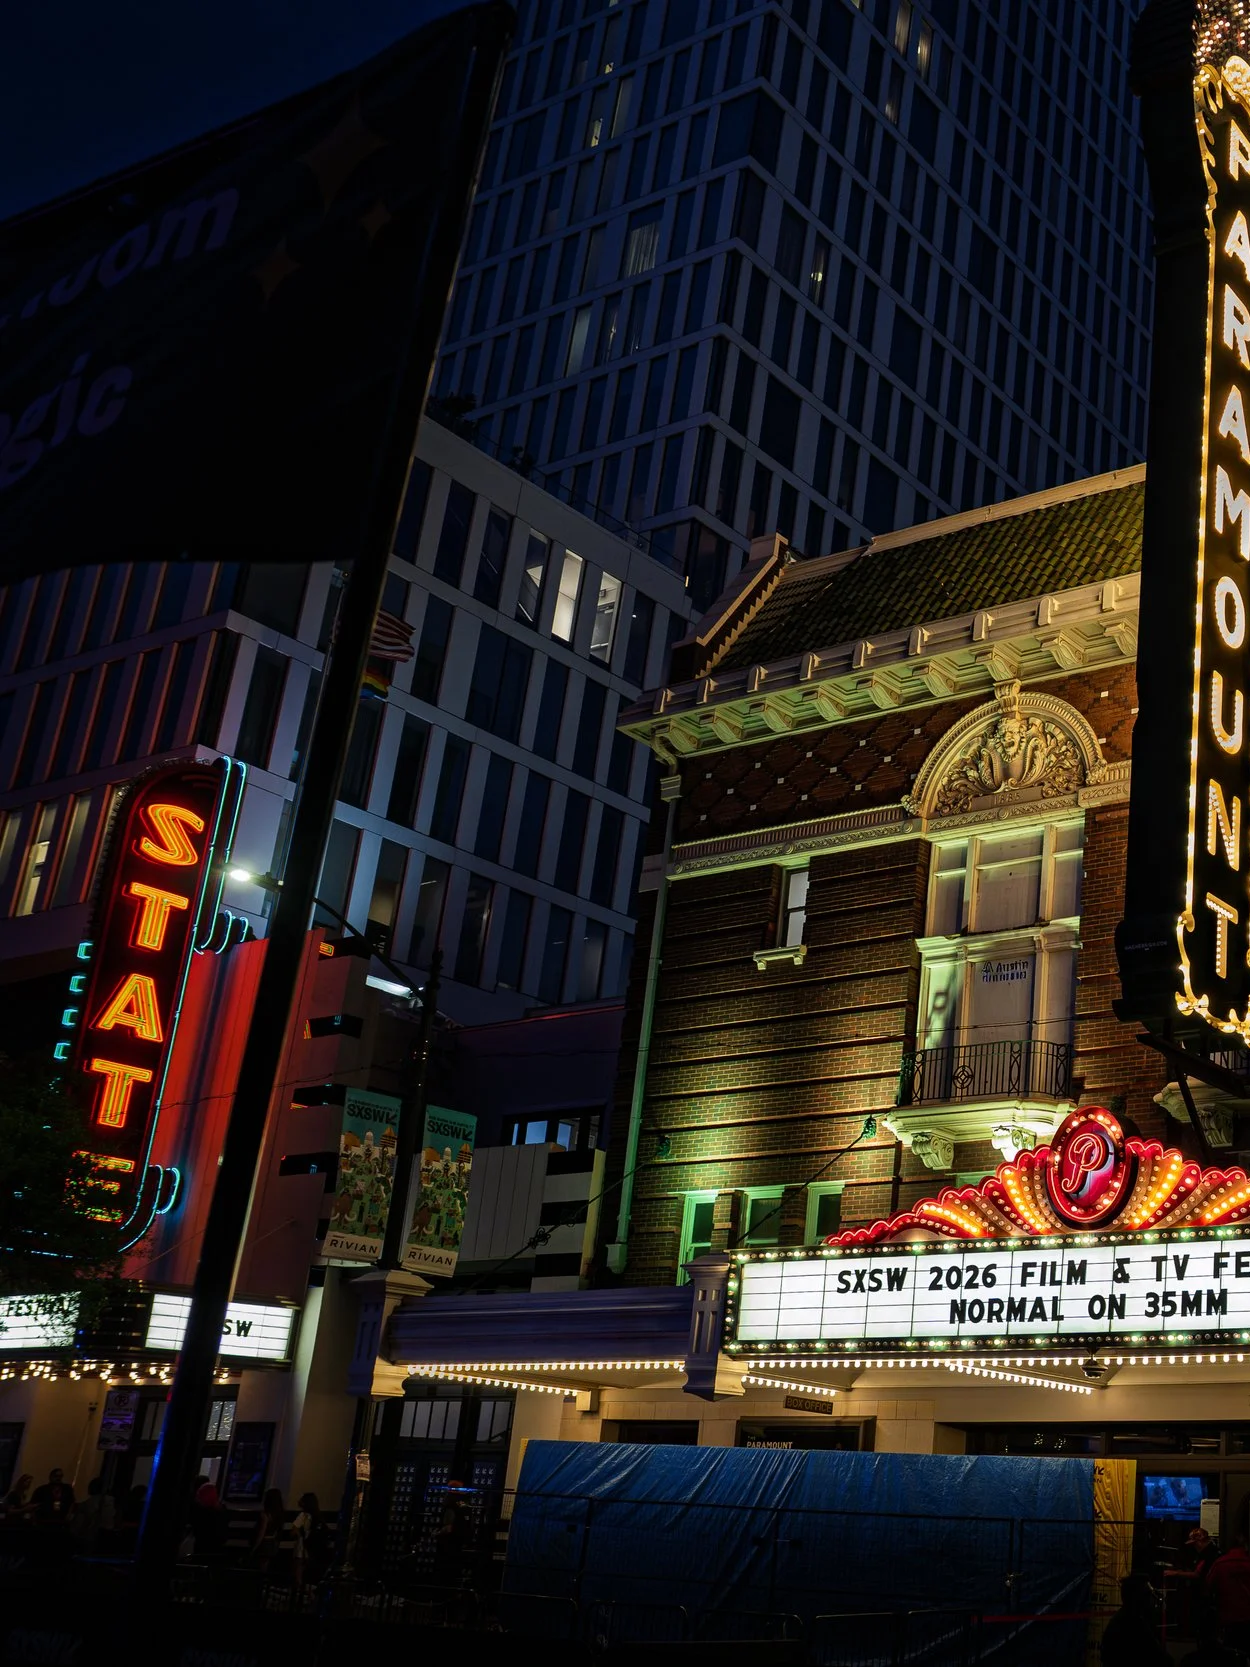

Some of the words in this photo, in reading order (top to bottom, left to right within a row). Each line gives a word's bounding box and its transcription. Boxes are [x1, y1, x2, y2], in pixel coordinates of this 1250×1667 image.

[0, 351, 133, 491] gic
[62, 802, 205, 1223] STATE
[346, 1103, 387, 1123] SXSW
[427, 1119, 462, 1139] SXSW
[329, 1239, 378, 1254] RIVIAN
[408, 1251, 453, 1266] RIVIAN
[836, 1266, 908, 1294] SXSW
[927, 1263, 997, 1291] 2026
[1020, 1259, 1088, 1287] FILM
[1113, 1257, 1131, 1284] &
[1151, 1254, 1190, 1282] TV
[949, 1295, 1065, 1324] NORMAL
[1087, 1293, 1126, 1320] ON
[1144, 1288, 1229, 1318] 35MM
[222, 1319, 253, 1338] SW
[787, 1397, 803, 1408] BOX
[805, 1400, 832, 1413] OFFICE
[746, 1441, 793, 1449] PARAMOUNT
